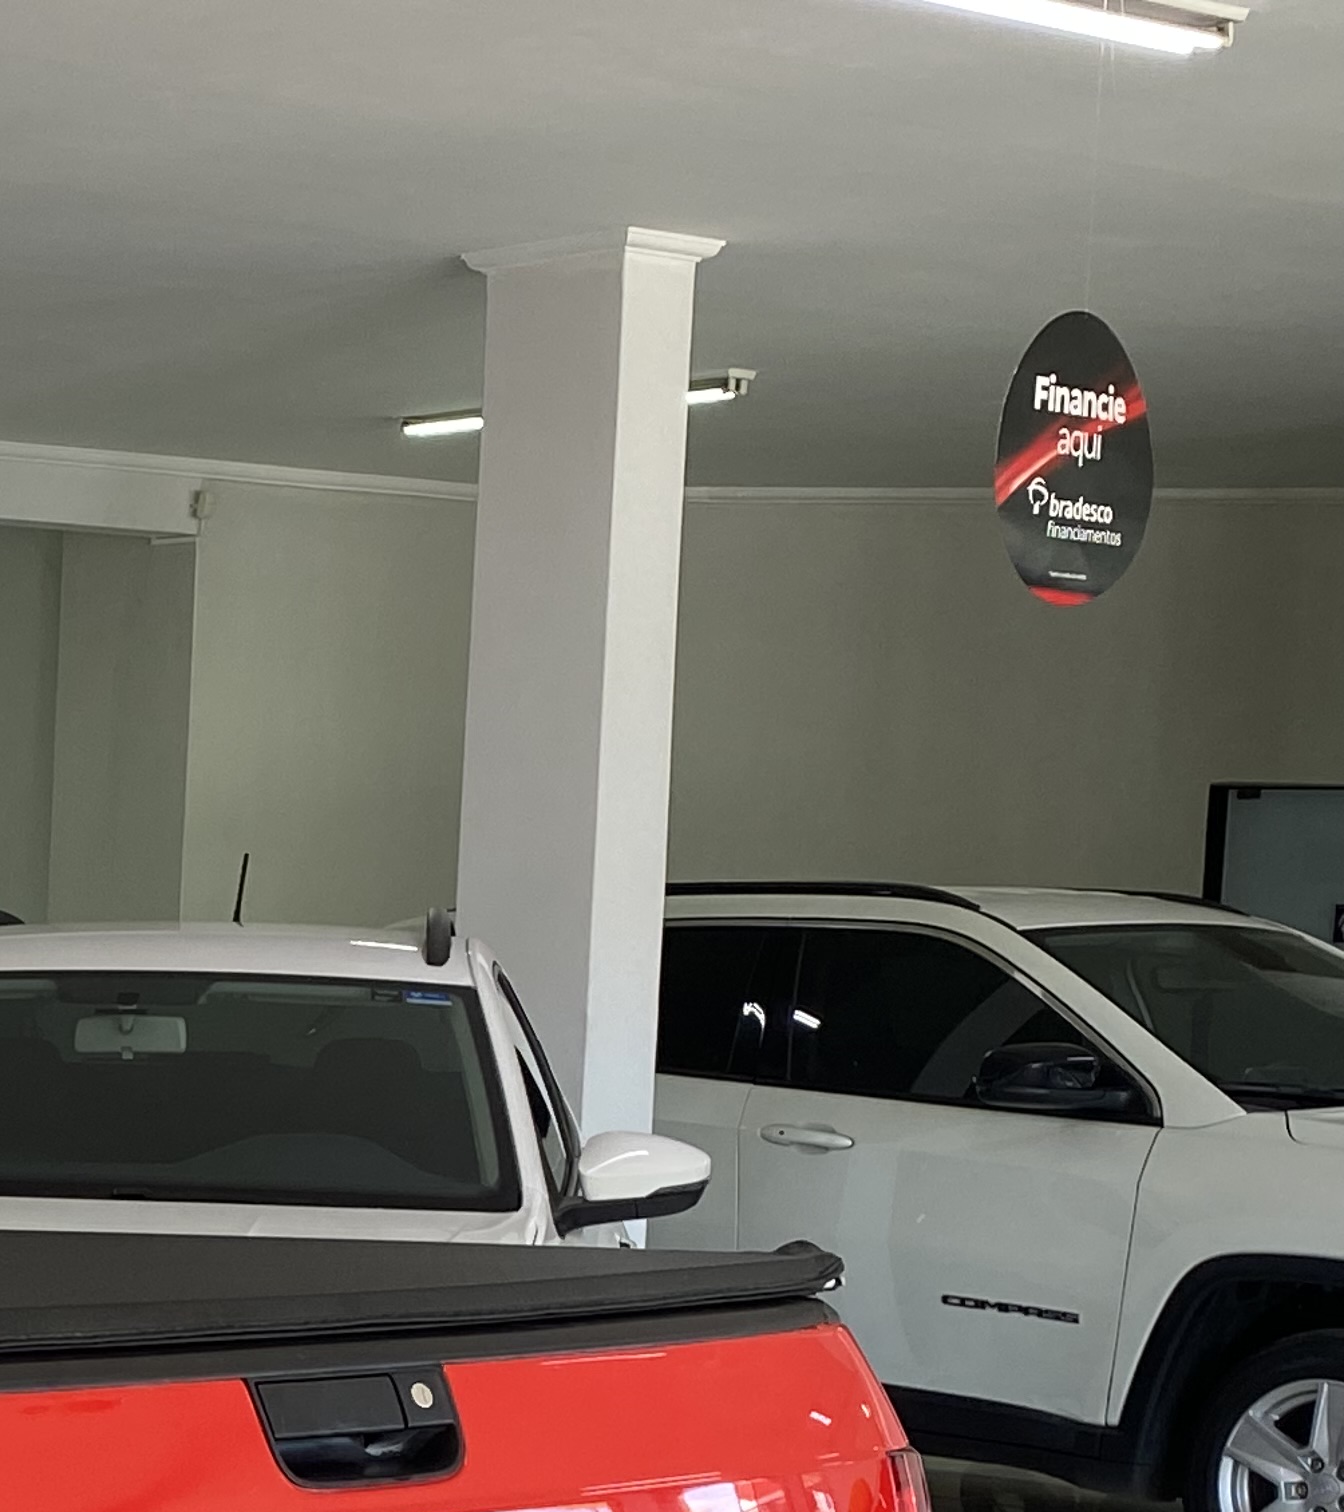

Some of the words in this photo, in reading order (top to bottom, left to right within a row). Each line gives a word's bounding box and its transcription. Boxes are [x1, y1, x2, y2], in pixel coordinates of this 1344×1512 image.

[1033, 373, 1127, 424] Financie
[1057, 425, 1103, 467] aqui
[1048, 492, 1114, 525] bradesco
[1045, 520, 1123, 547] financiamentos
